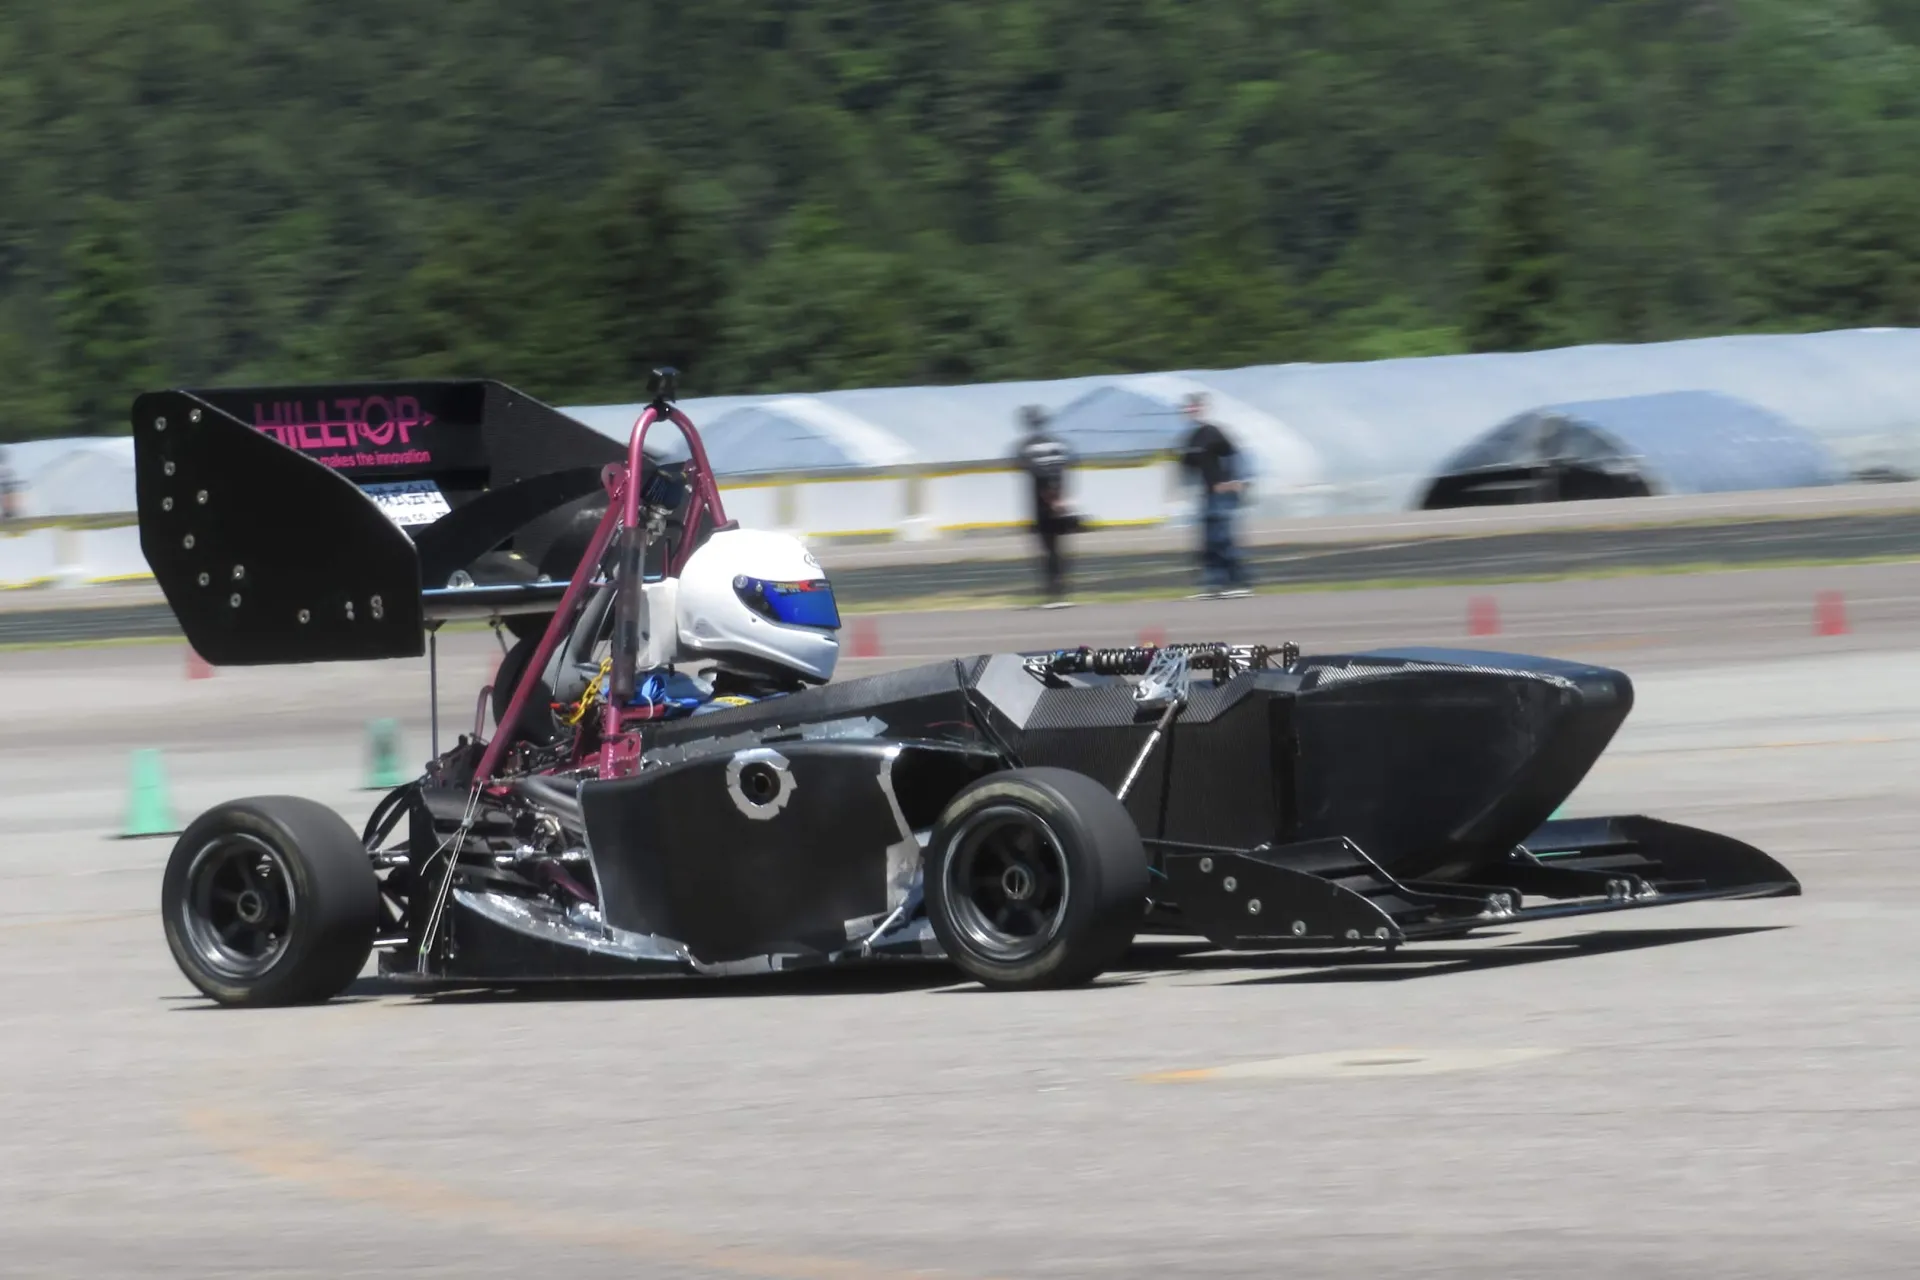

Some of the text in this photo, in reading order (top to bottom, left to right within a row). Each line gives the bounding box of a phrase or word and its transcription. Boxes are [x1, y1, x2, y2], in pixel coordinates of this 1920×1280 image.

[254, 395, 419, 450] HILLTOP
[356, 451, 375, 467] the
[374, 448, 431, 465] innovation
